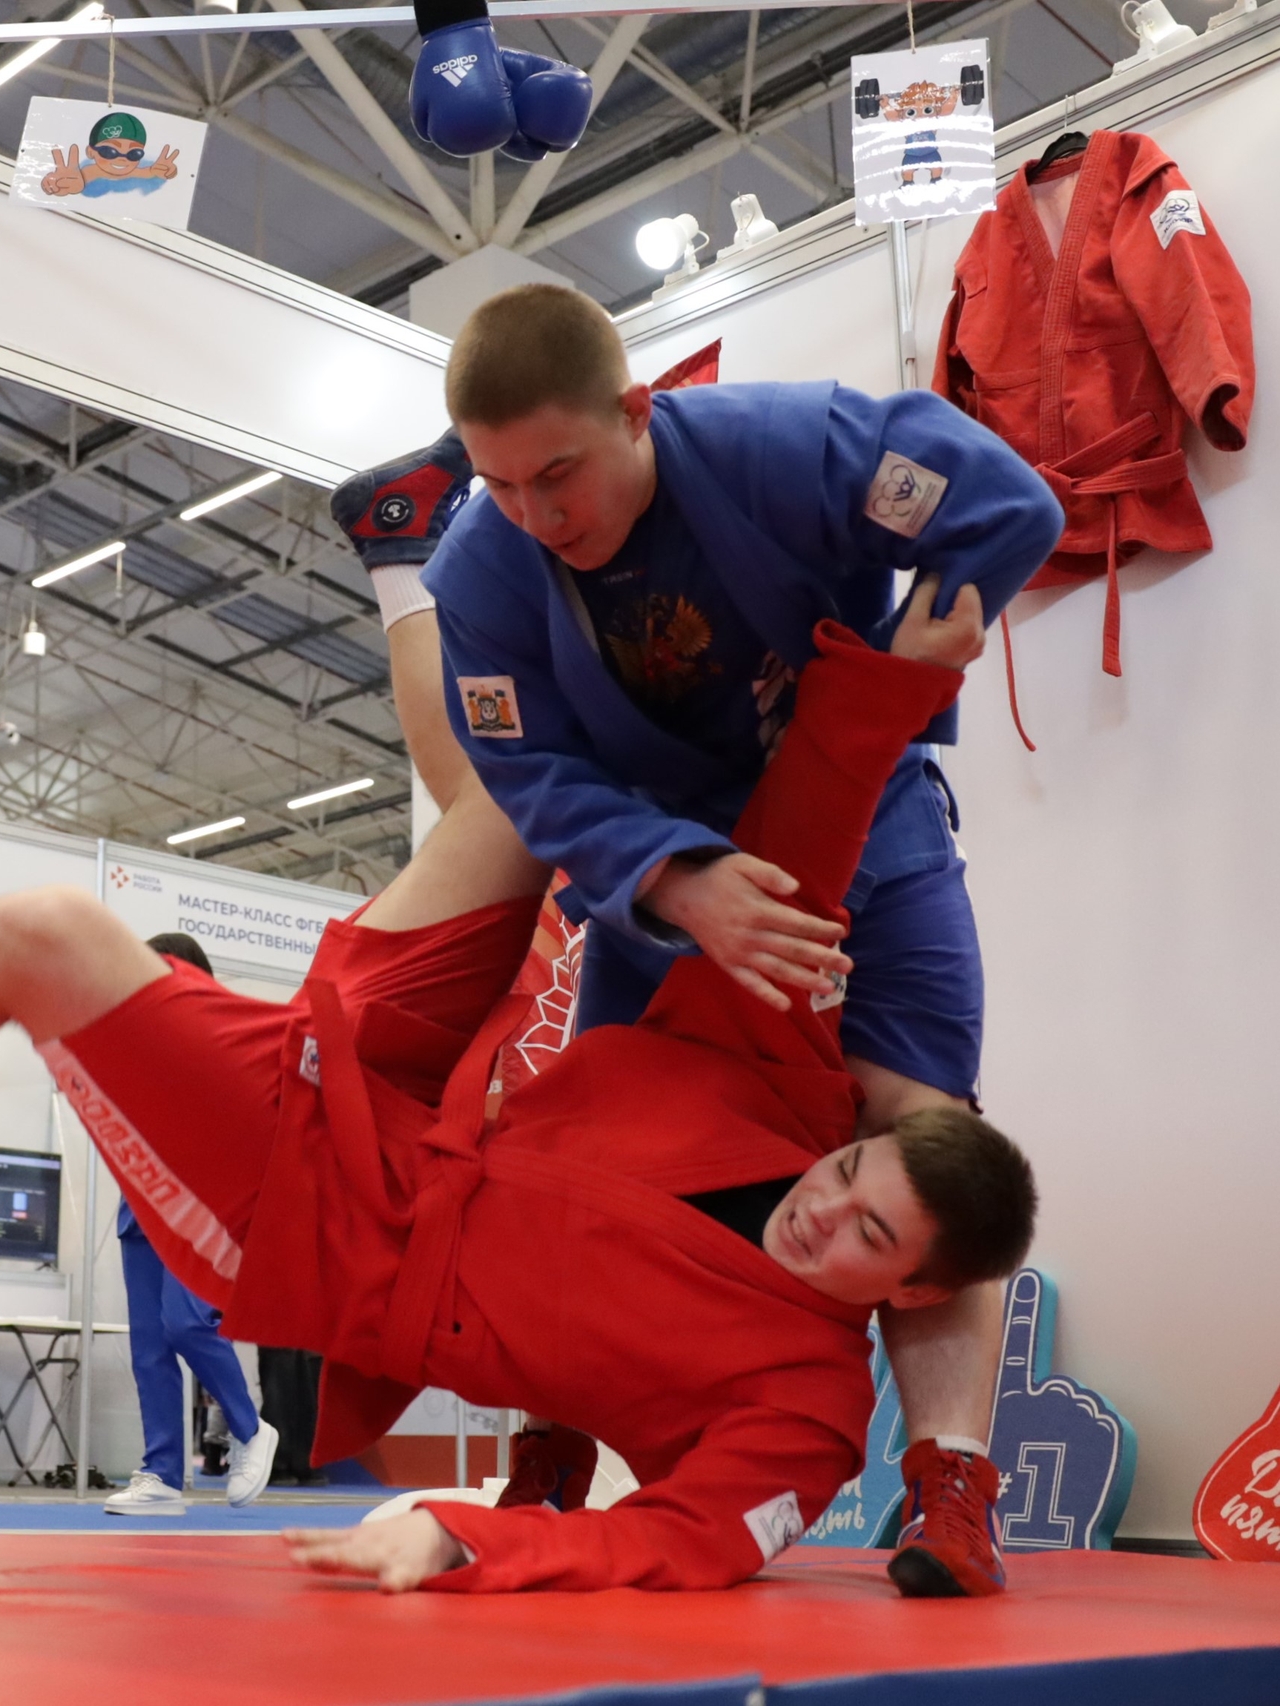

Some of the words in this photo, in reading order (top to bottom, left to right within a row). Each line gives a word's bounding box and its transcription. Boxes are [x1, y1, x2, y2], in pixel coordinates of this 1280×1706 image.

[432, 54, 478, 74] adidas
[178, 893, 292, 928] МАСТЕР-КЛАСС
[295, 917, 326, 935] ФГБ
[178, 917, 317, 957] ГОСУДАРСТВЕННЫ
